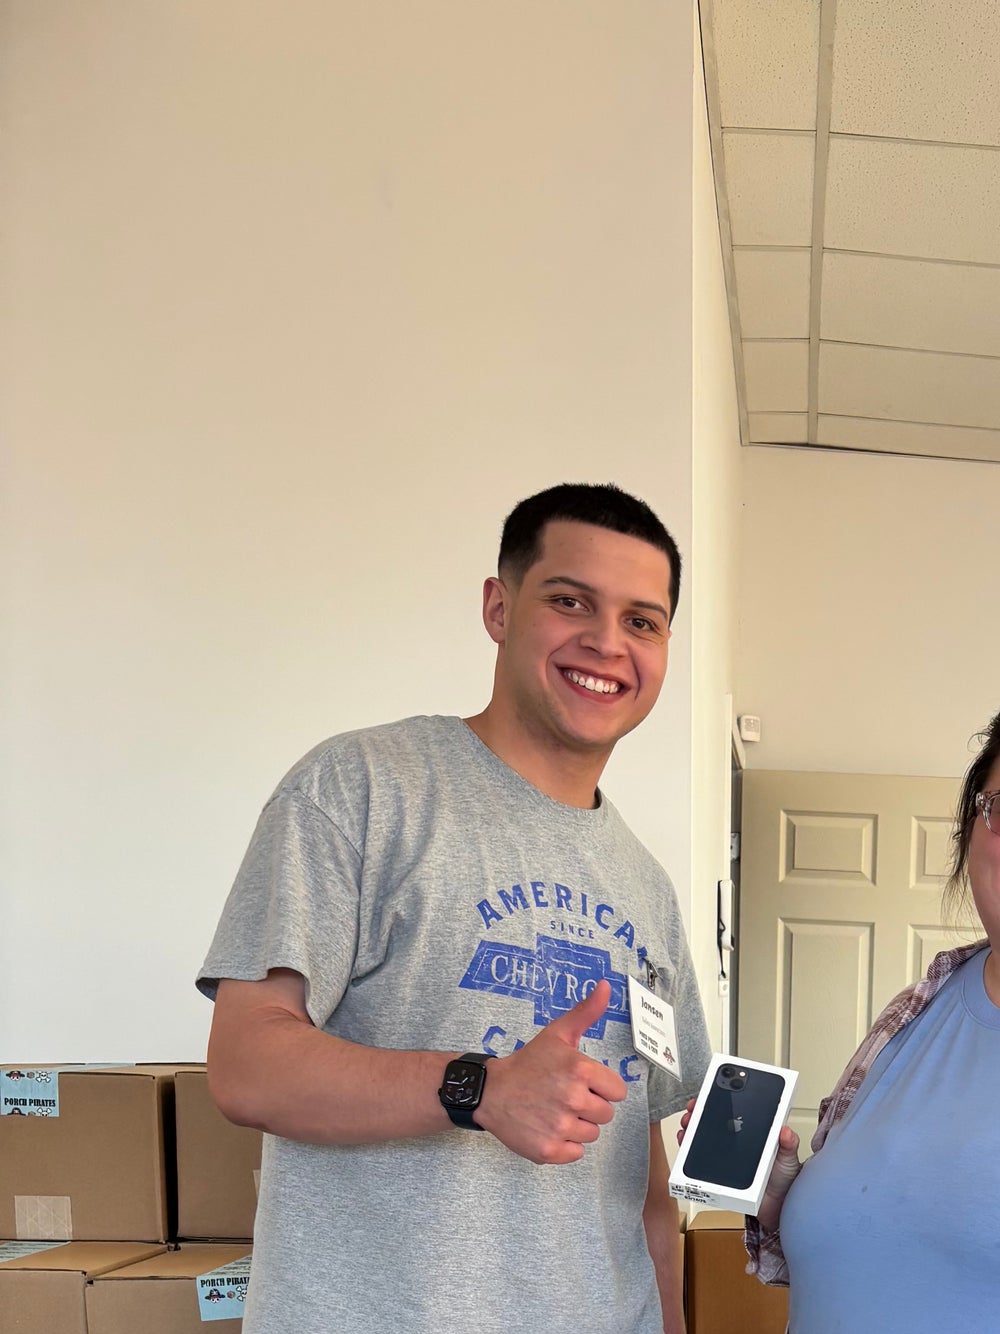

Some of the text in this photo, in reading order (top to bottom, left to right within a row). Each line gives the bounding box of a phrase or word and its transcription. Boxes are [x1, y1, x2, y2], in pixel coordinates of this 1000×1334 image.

[549, 920, 595, 939] SINCE
[491, 955, 629, 1013] CHEVRO
[4, 1097, 56, 1107] PORCH PIRATES
[200, 1277, 250, 1288] PORCH PIRAT
